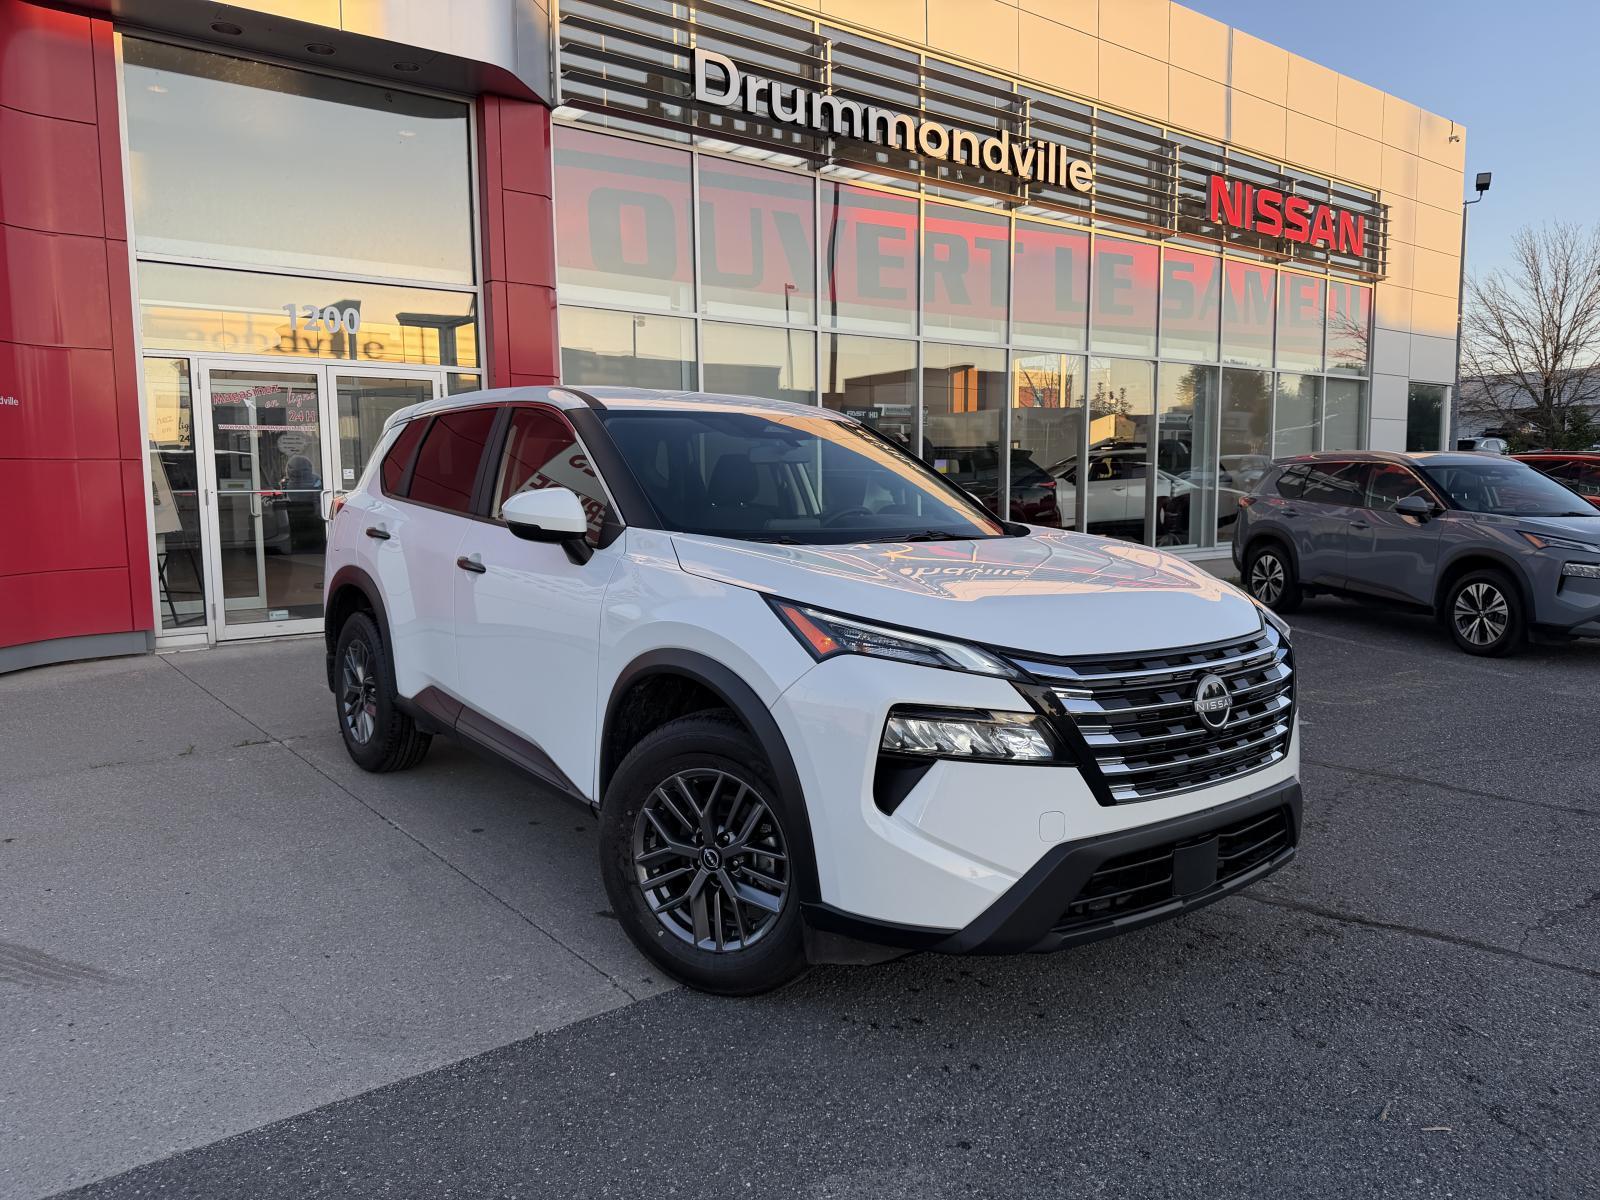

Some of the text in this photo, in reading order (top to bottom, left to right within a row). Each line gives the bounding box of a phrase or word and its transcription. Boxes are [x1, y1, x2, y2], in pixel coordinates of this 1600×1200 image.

[692, 47, 1094, 193] Drummondville
[1206, 174, 1365, 257] NISSAN
[586, 186, 1362, 333] OUVERT LE SAMEDI
[282, 303, 361, 335] 1200
[212, 384, 282, 405] Magasinez
[1196, 698, 1232, 711] NISSAN
